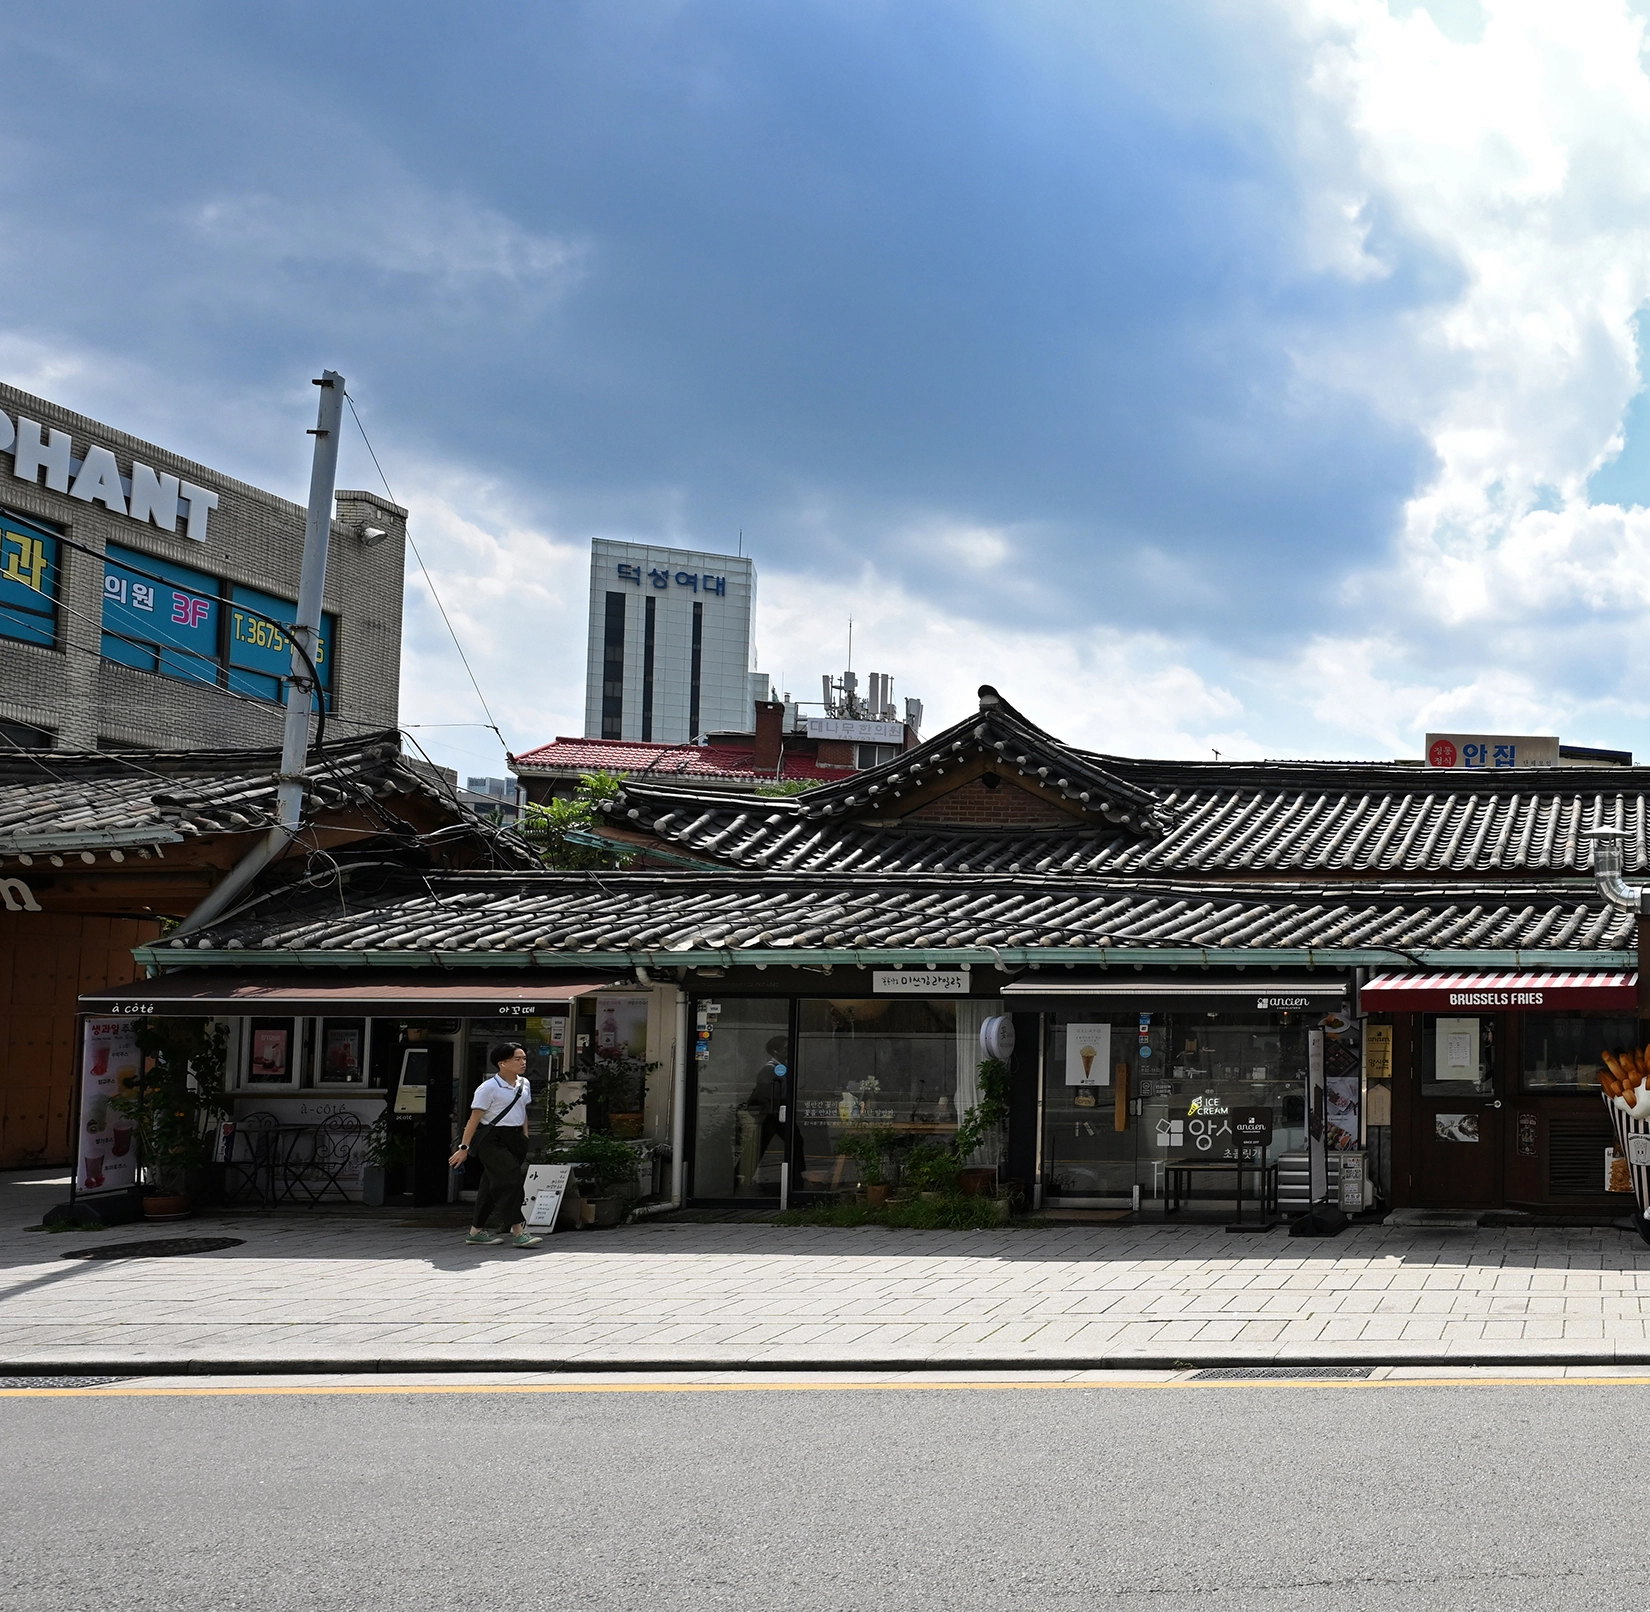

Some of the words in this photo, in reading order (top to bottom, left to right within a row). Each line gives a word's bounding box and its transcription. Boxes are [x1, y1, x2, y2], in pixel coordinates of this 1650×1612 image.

[617, 563, 726, 597] 덕성여대
[104, 575, 154, 611] 의원
[172, 591, 209, 628] 3F
[809, 720, 902, 737] 대나무한의원
[1462, 743, 1516, 768] 안집
[1269, 997, 1310, 1007] ancien
[1449, 993, 1508, 1006] BRUSSELS
[1511, 992, 1543, 1005] FRIES
[112, 1002, 120, 1014] à
[124, 1002, 154, 1014] côté
[499, 1005, 535, 1015] 아꼬떼
[91, 1024, 120, 1036] 생과일
[1205, 1098, 1220, 1106] ICE
[1197, 1107, 1228, 1115] CREAM
